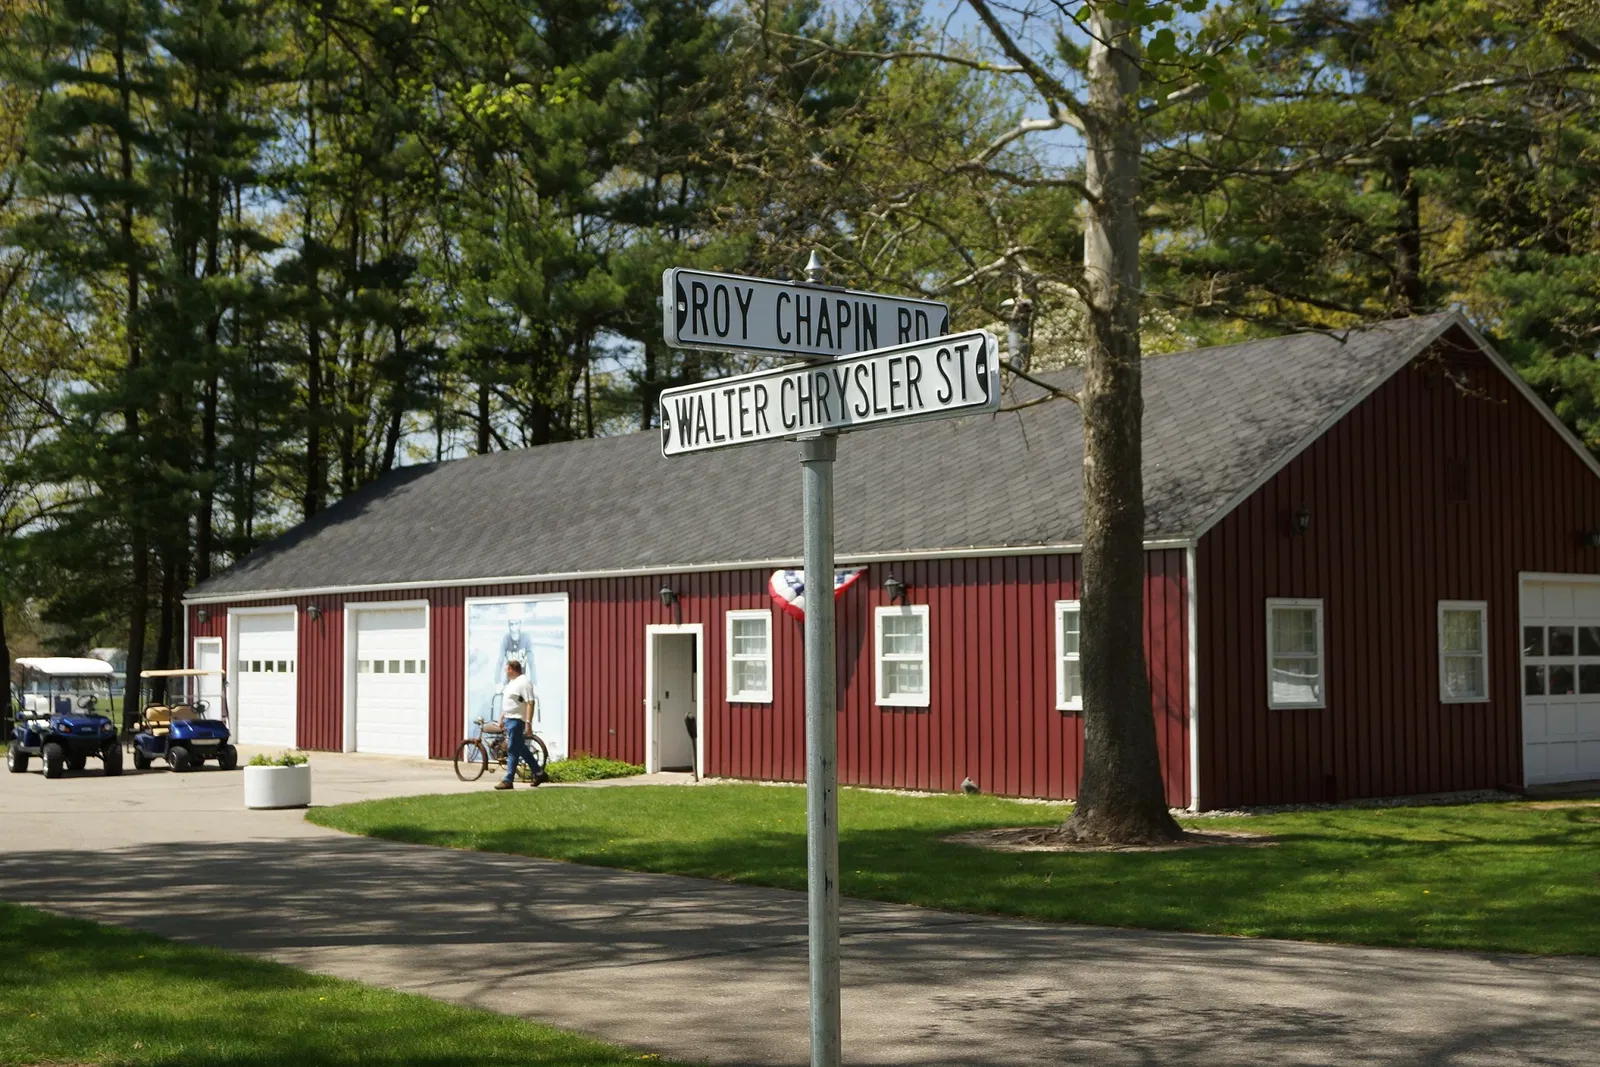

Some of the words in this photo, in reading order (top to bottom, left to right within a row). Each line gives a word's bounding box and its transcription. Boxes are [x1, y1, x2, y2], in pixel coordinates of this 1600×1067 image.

[691, 281, 754, 340] ROY
[776, 291, 878, 352] CHAPIN
[897, 306, 930, 345] RD
[675, 383, 771, 448] WALTER
[780, 354, 924, 430] CHRYSLER
[936, 344, 970, 405] ST
